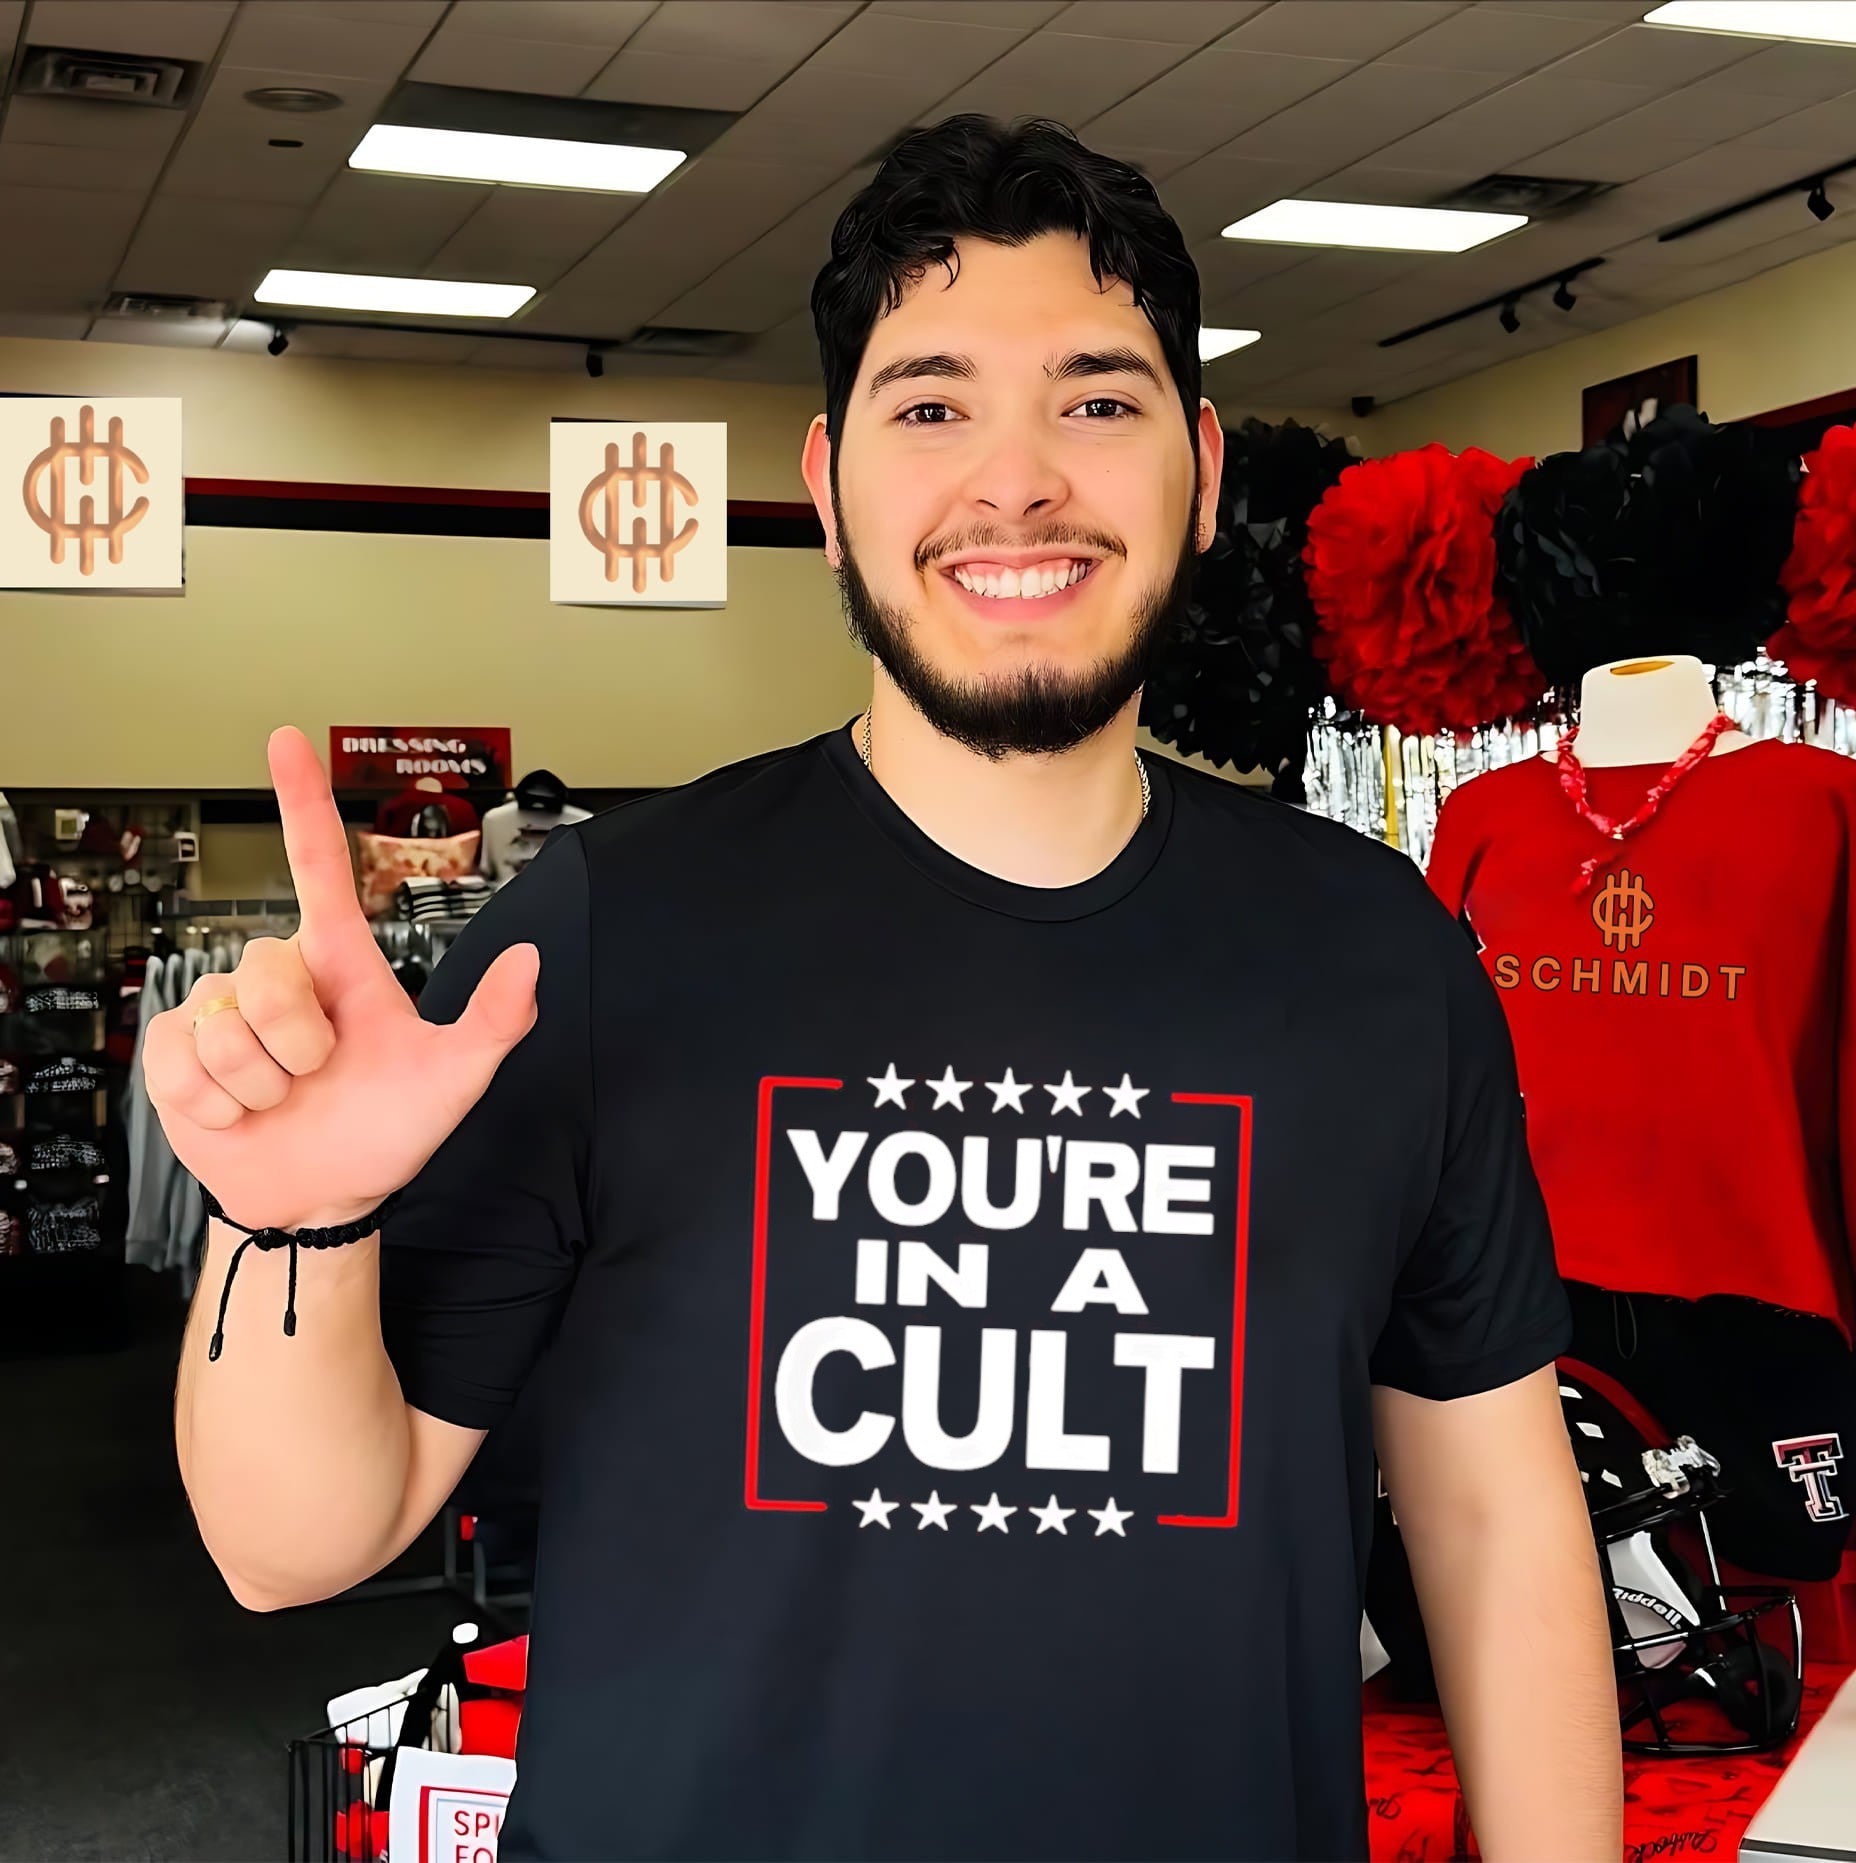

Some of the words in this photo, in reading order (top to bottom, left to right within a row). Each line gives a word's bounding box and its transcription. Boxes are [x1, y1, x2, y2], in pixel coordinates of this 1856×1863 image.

[342, 737, 466, 754] DRESSING
[396, 758, 487, 774] ROOMS
[1494, 953, 1747, 1000] SCHMIDT
[786, 1129, 1215, 1235] YOU'RE
[855, 1239, 989, 1308] IN
[1050, 1248, 1150, 1315] A
[775, 1316, 1215, 1474] CULT
